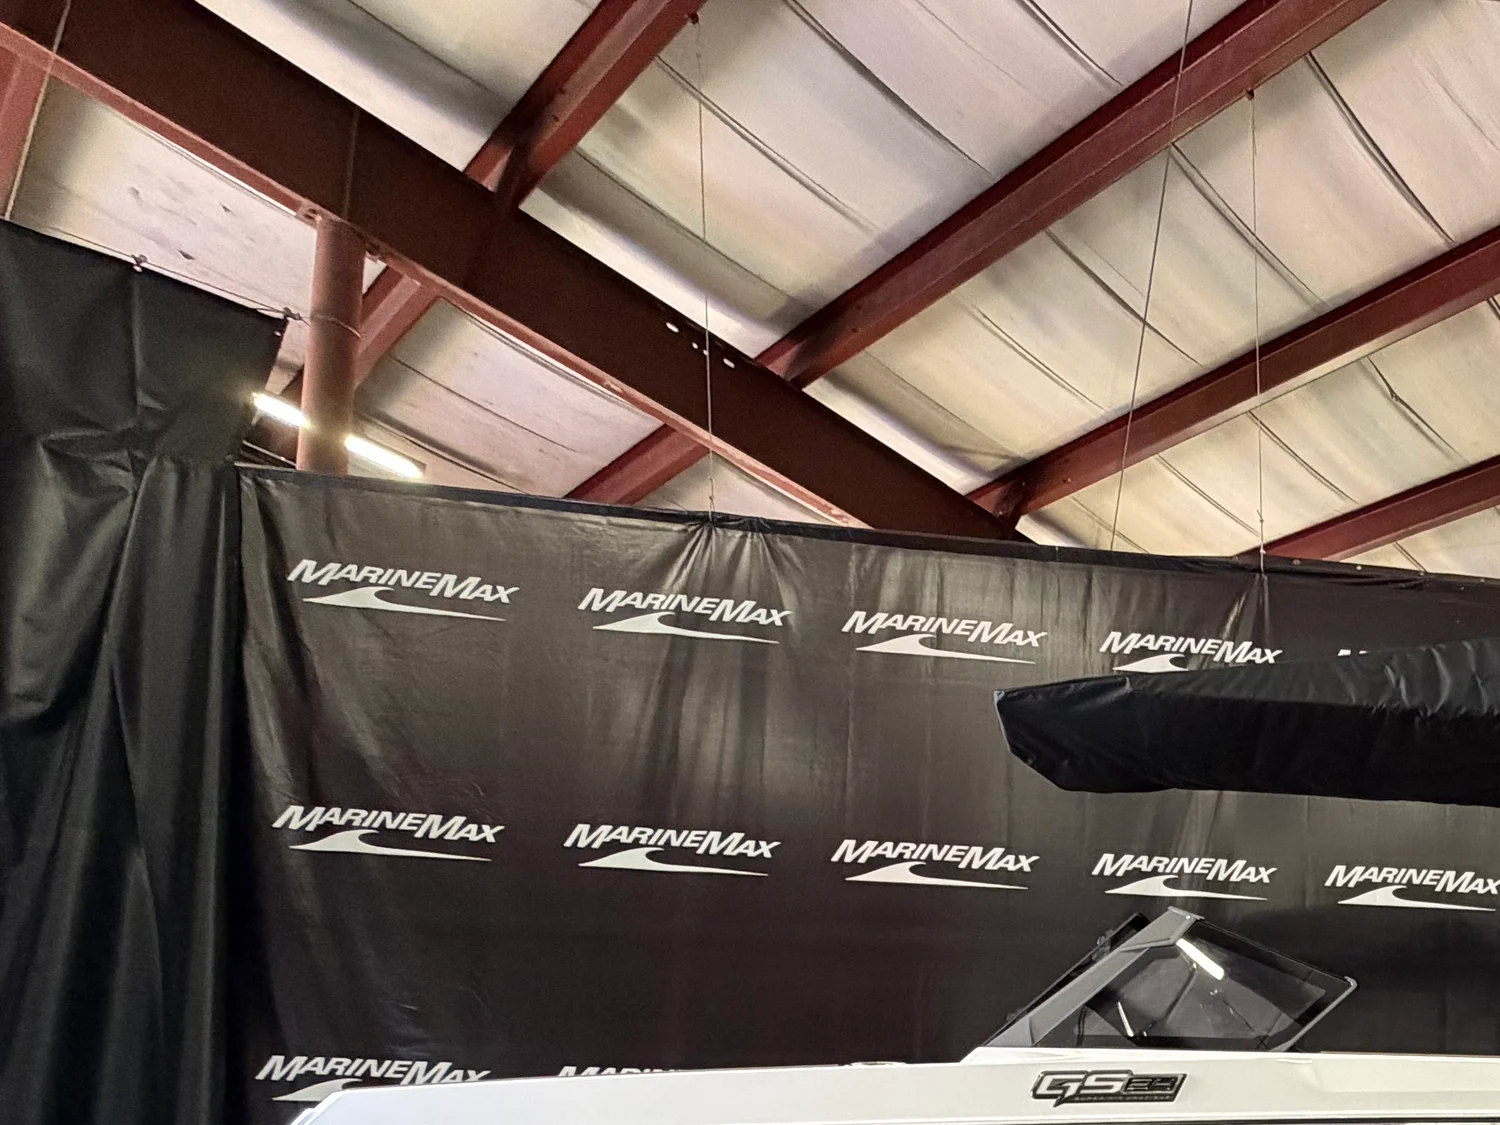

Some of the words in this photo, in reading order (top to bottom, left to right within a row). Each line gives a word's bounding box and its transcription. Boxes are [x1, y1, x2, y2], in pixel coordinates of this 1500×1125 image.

[287, 559, 519, 603] MARINEMAX
[578, 588, 791, 627] MARINEMAX
[842, 611, 1047, 647] MARINEMAX
[1099, 632, 1282, 663] MARINEMAX
[273, 805, 504, 842] MARINEMAX
[564, 824, 781, 859] MARINEMAX
[831, 839, 1040, 871] MARINEMAX
[1092, 854, 1277, 884] MARINEMAX
